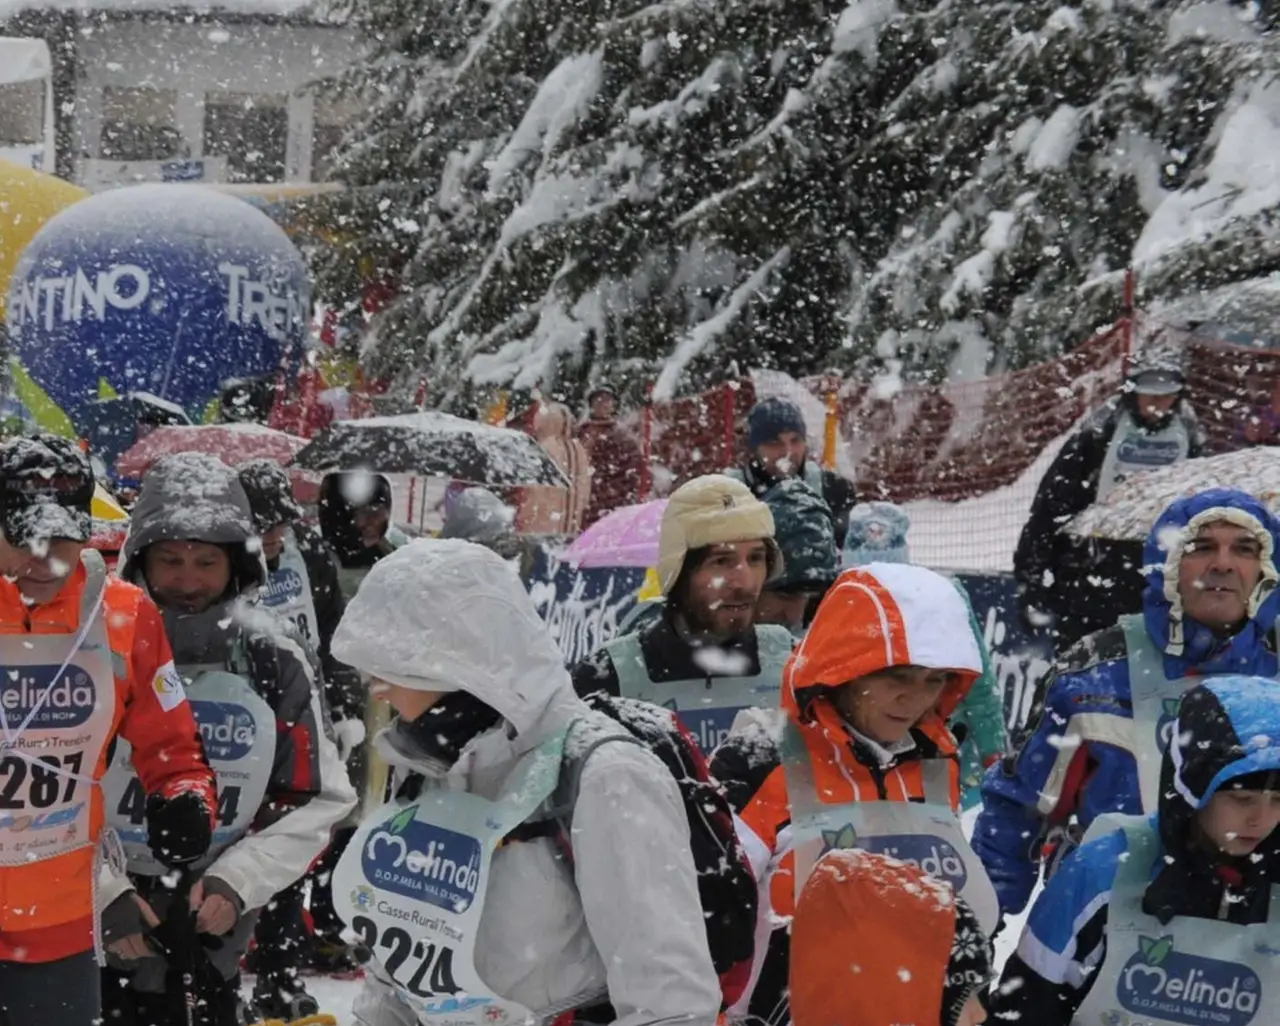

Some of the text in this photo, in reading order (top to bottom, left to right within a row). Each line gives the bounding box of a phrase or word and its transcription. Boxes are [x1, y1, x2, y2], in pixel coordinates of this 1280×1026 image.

[378, 900, 410, 922] Casse
[1125, 963, 1258, 1013] Melinda
[1209, 1011, 1231, 1023] NON
